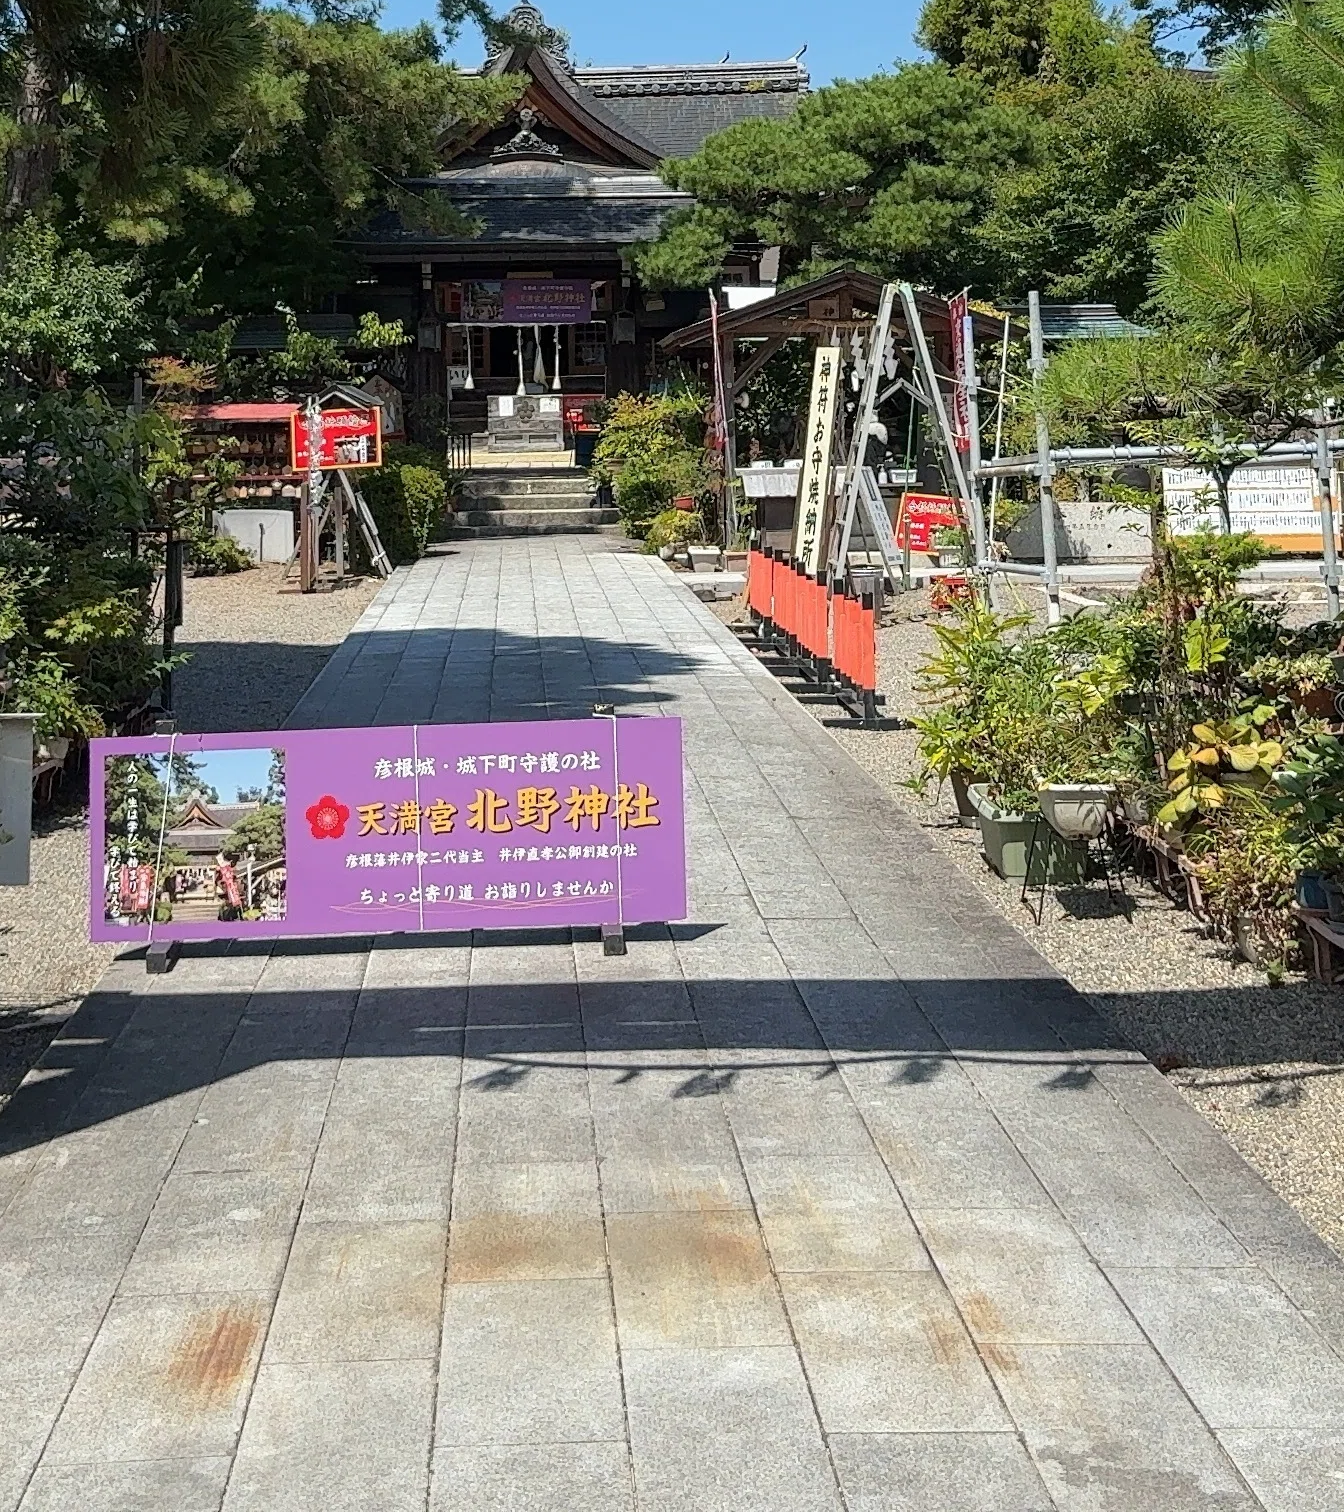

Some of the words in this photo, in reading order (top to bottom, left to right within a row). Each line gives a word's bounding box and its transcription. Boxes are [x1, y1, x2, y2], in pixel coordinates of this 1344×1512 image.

[373, 750, 602, 780] 彦根城・城下町守護の社
[355, 798, 459, 837] 天満宮
[465, 782, 662, 834] 北野神社
[360, 883, 474, 905] ちょっと寄り道
[484, 880, 614, 901] お詣りしませんか
